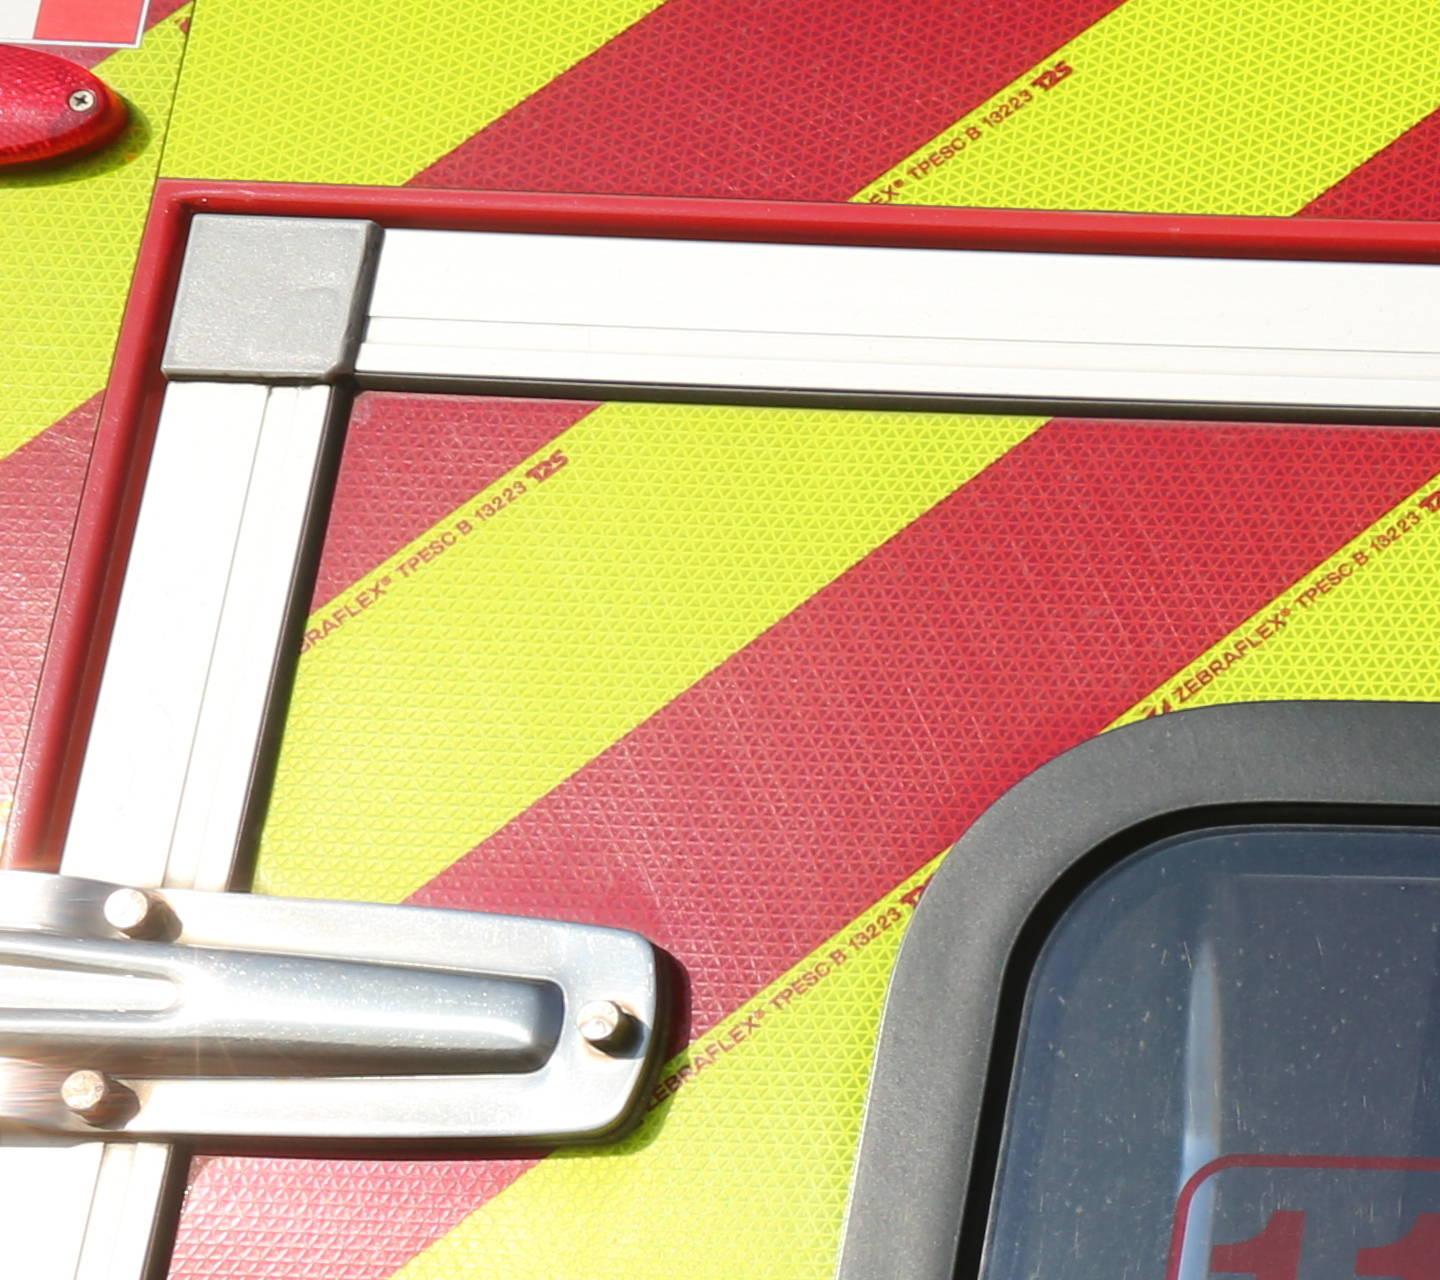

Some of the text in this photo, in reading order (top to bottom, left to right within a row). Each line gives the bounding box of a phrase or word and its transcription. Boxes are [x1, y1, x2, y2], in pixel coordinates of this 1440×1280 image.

[906, 136, 965, 181] TPESC
[964, 124, 982, 141] B
[981, 87, 1034, 129] 13223
[395, 529, 457, 578] TPESC
[455, 518, 473, 536] B
[472, 478, 528, 523] 13223
[1294, 562, 1353, 608] TPESC
[1351, 550, 1369, 567] B
[1368, 509, 1422, 554] 13223
[769, 905, 904, 1010] TPESC B 13223
